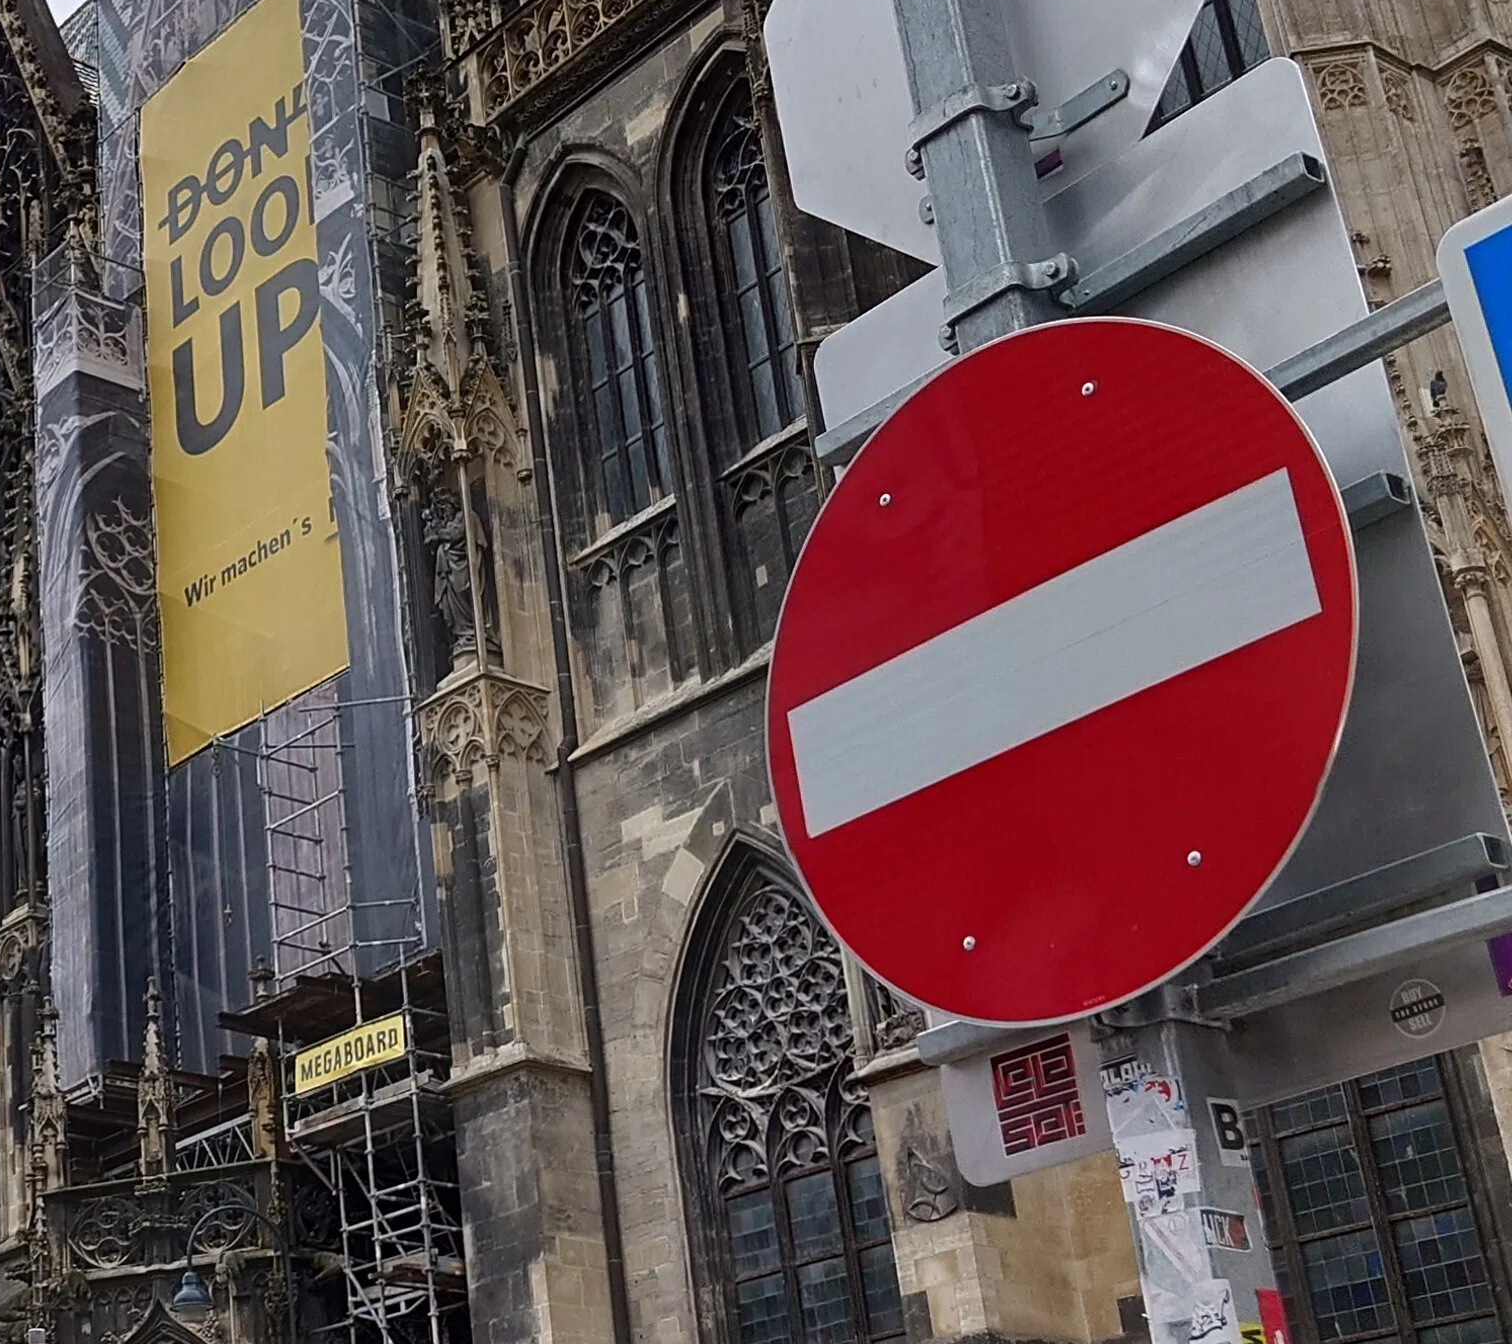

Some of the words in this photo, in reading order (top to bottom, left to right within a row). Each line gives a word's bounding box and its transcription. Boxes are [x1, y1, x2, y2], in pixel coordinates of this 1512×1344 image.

[172, 258, 320, 455] UP
[184, 574, 217, 607] Wir
[300, 1027, 398, 1082] MEGABOARD
